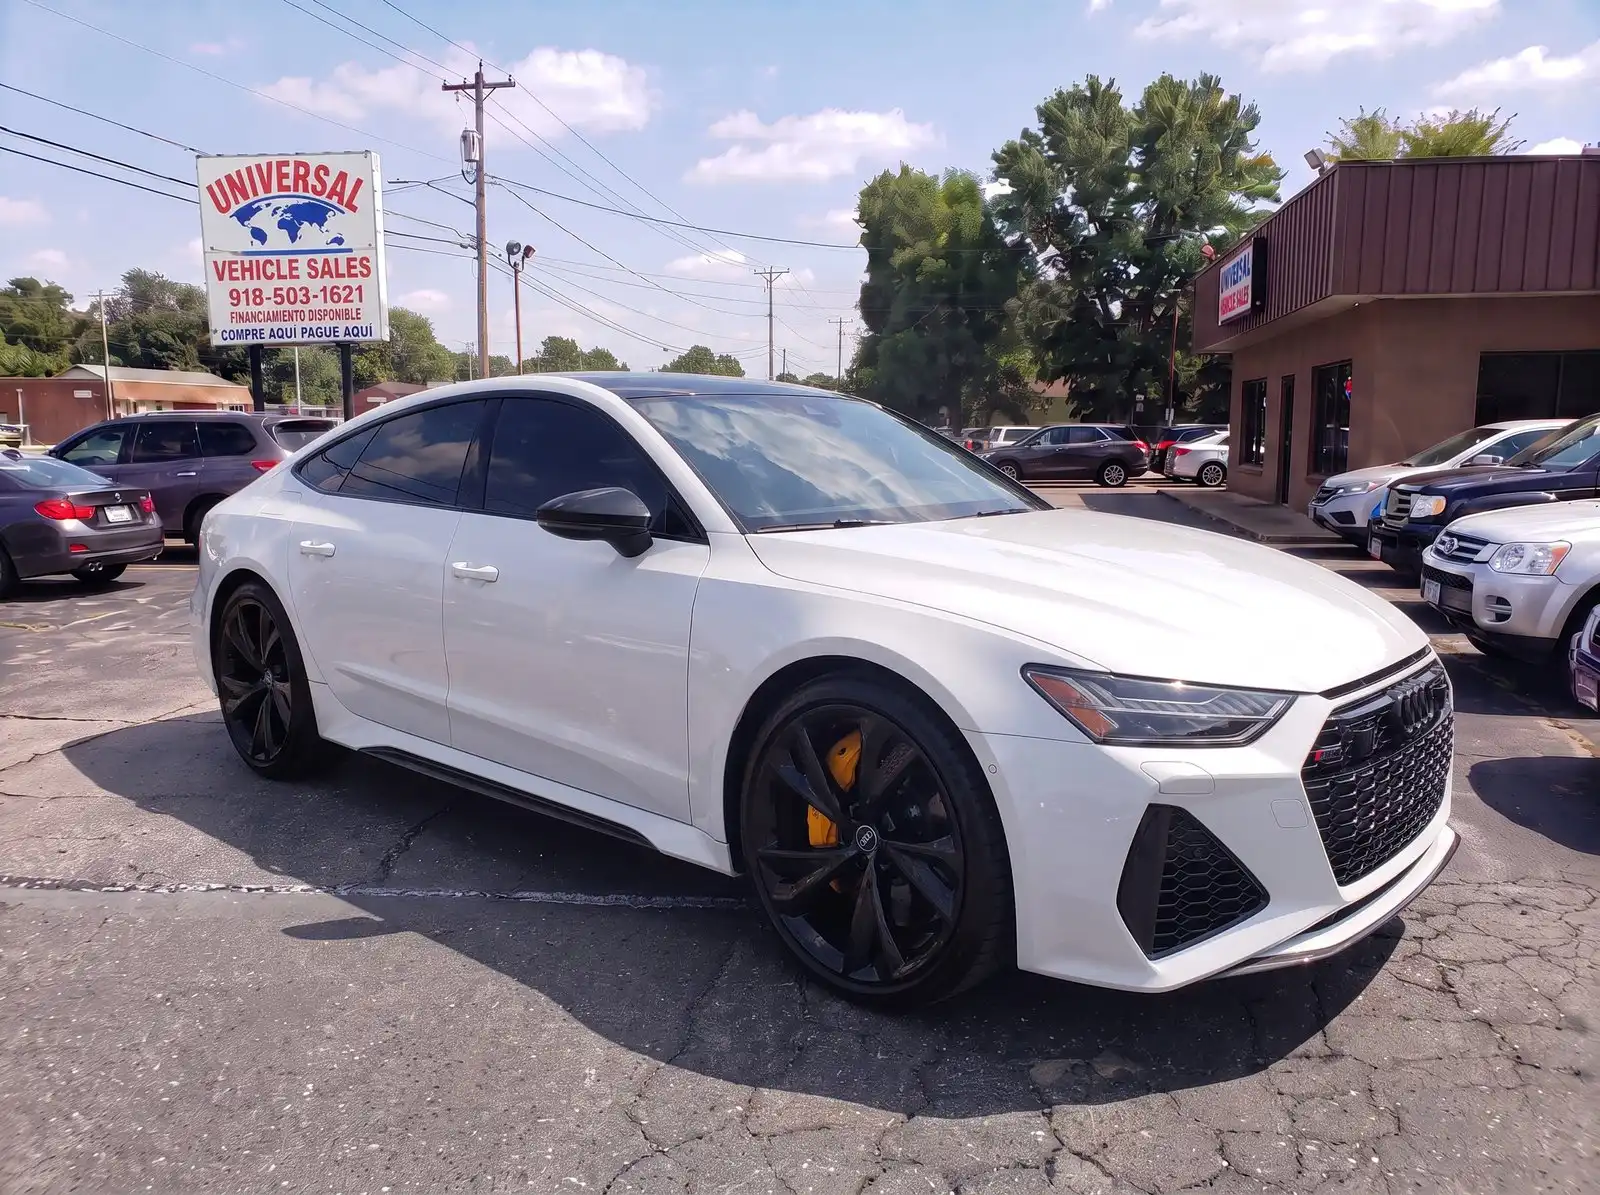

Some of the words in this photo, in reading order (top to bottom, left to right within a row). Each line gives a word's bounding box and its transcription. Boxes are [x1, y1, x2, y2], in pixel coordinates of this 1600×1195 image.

[206, 160, 364, 214] UNIVERSAL
[213, 259, 300, 281] VEHICLE
[307, 256, 371, 279] SALES
[229, 285, 363, 307] 918-503-1621
[230, 310, 305, 324] FINANCIAMIENTO
[308, 308, 361, 322] DISPONIBLE
[221, 328, 265, 341] COMPRE
[301, 326, 340, 339] PAGUE
